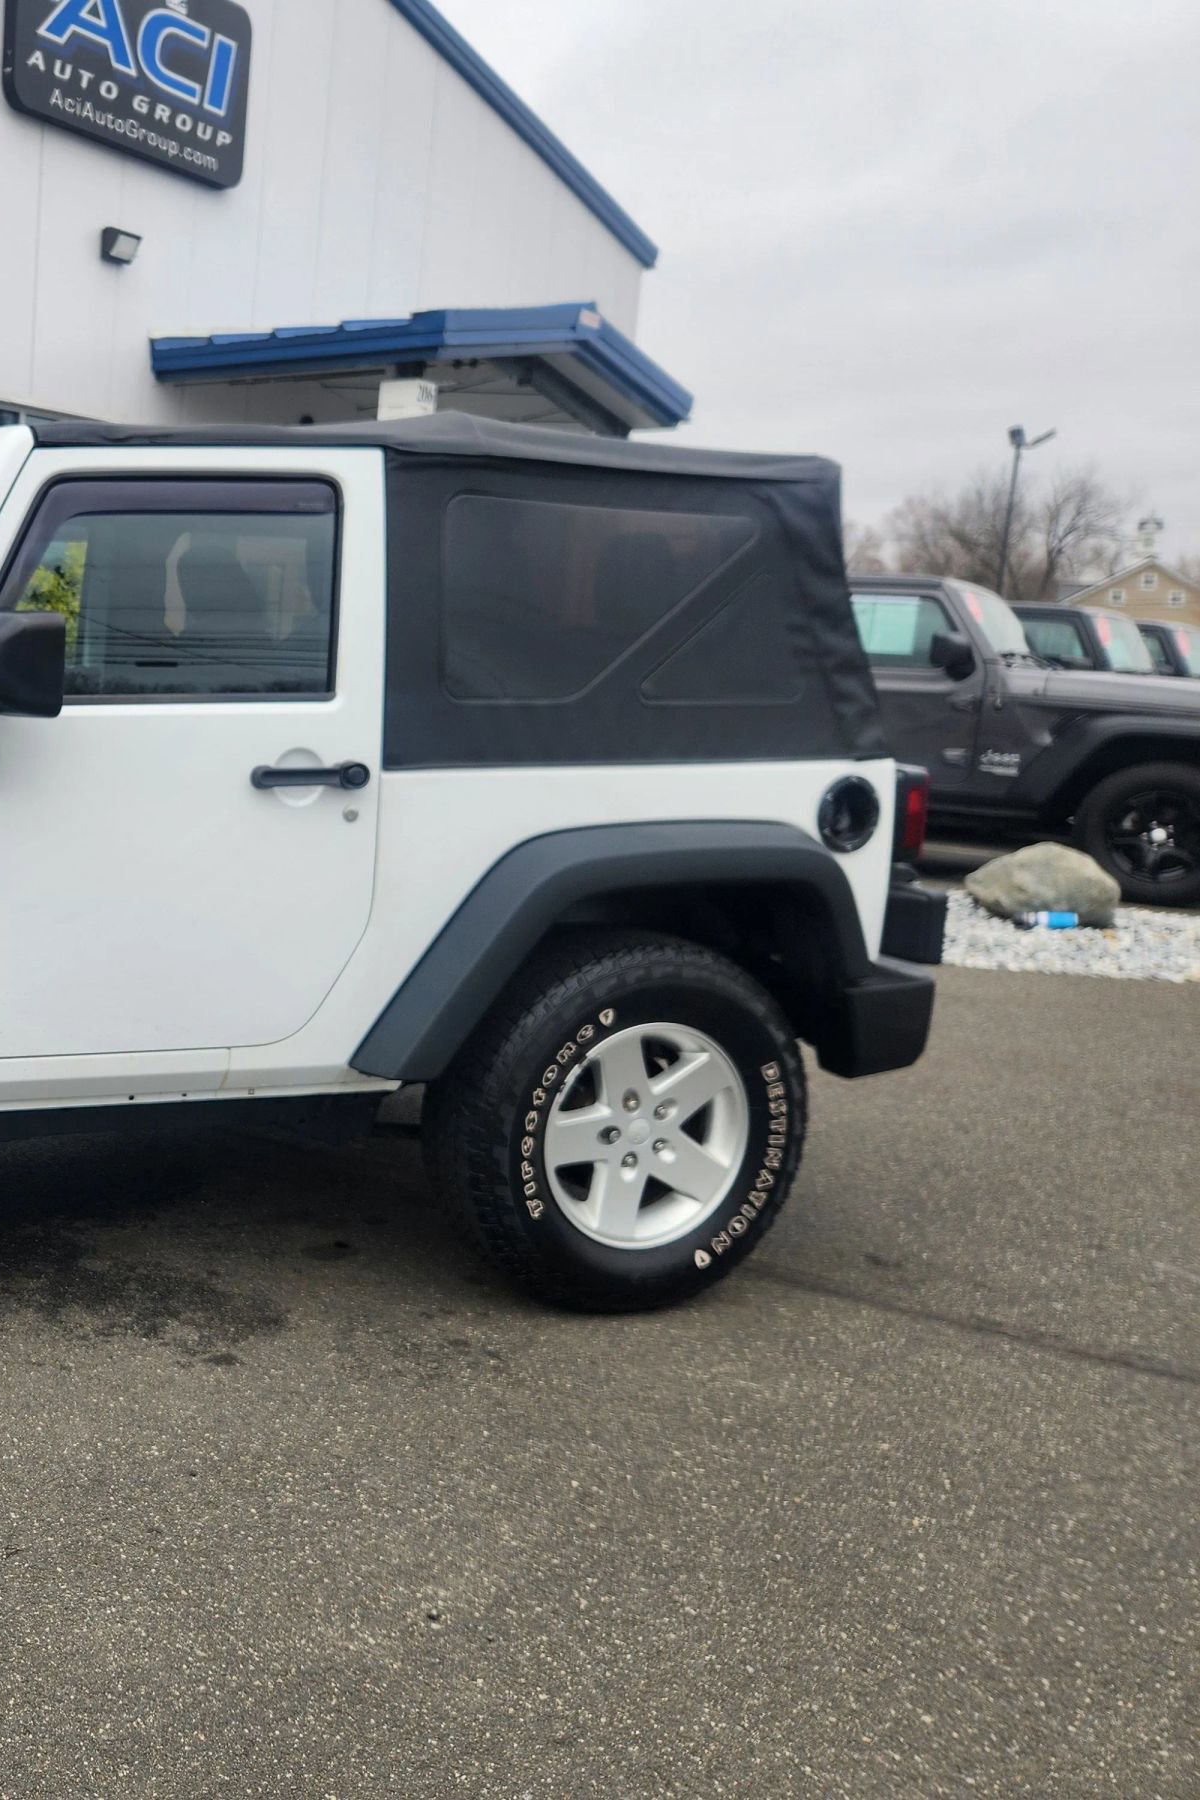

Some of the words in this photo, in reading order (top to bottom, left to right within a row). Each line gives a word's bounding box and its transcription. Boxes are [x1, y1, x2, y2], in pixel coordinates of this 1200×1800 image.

[26, 50, 119, 100] AUTO
[131, 95, 233, 147] GROUP
[36, 0, 238, 117] ACI
[49, 88, 219, 171] AciAutoGroup.com
[711, 1061, 787, 1254] DESTINATION
